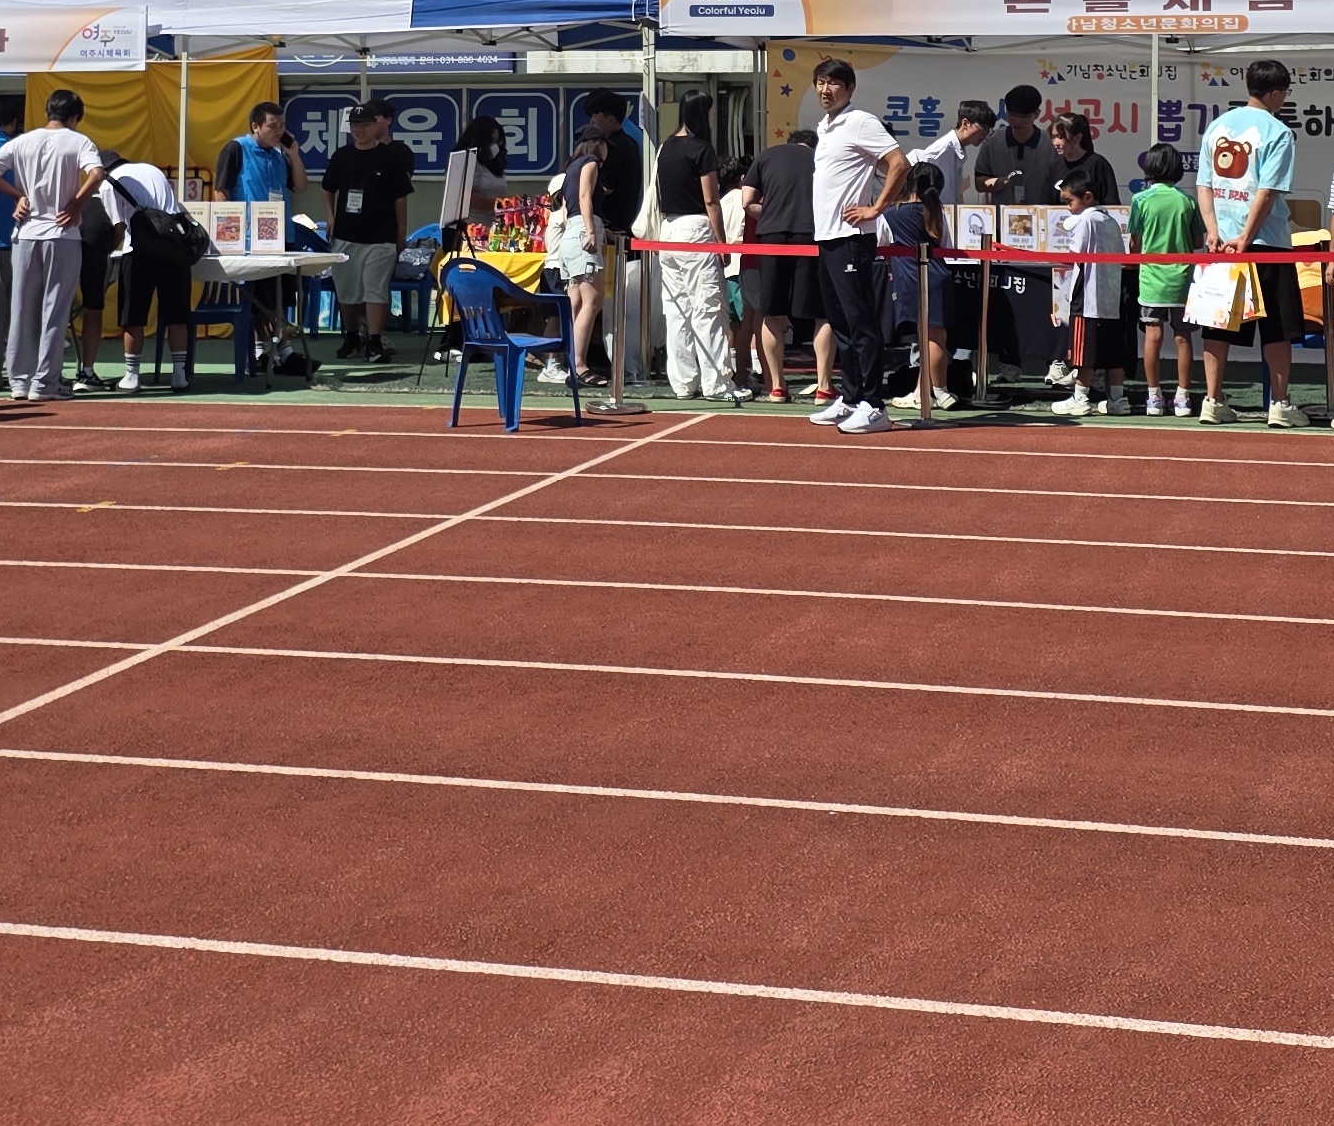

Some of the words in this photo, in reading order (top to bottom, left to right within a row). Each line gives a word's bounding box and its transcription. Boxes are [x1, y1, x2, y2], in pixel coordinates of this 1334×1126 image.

[698, 6, 737, 15] Colorful
[738, 6, 766, 16] Yeoju
[82, 24, 116, 48] 여주
[80, 48, 131, 58] 여주시체육회
[883, 95, 945, 138] 콘홀
[187, 181, 198, 200] 3
[1228, 189, 1250, 202] BEAR
